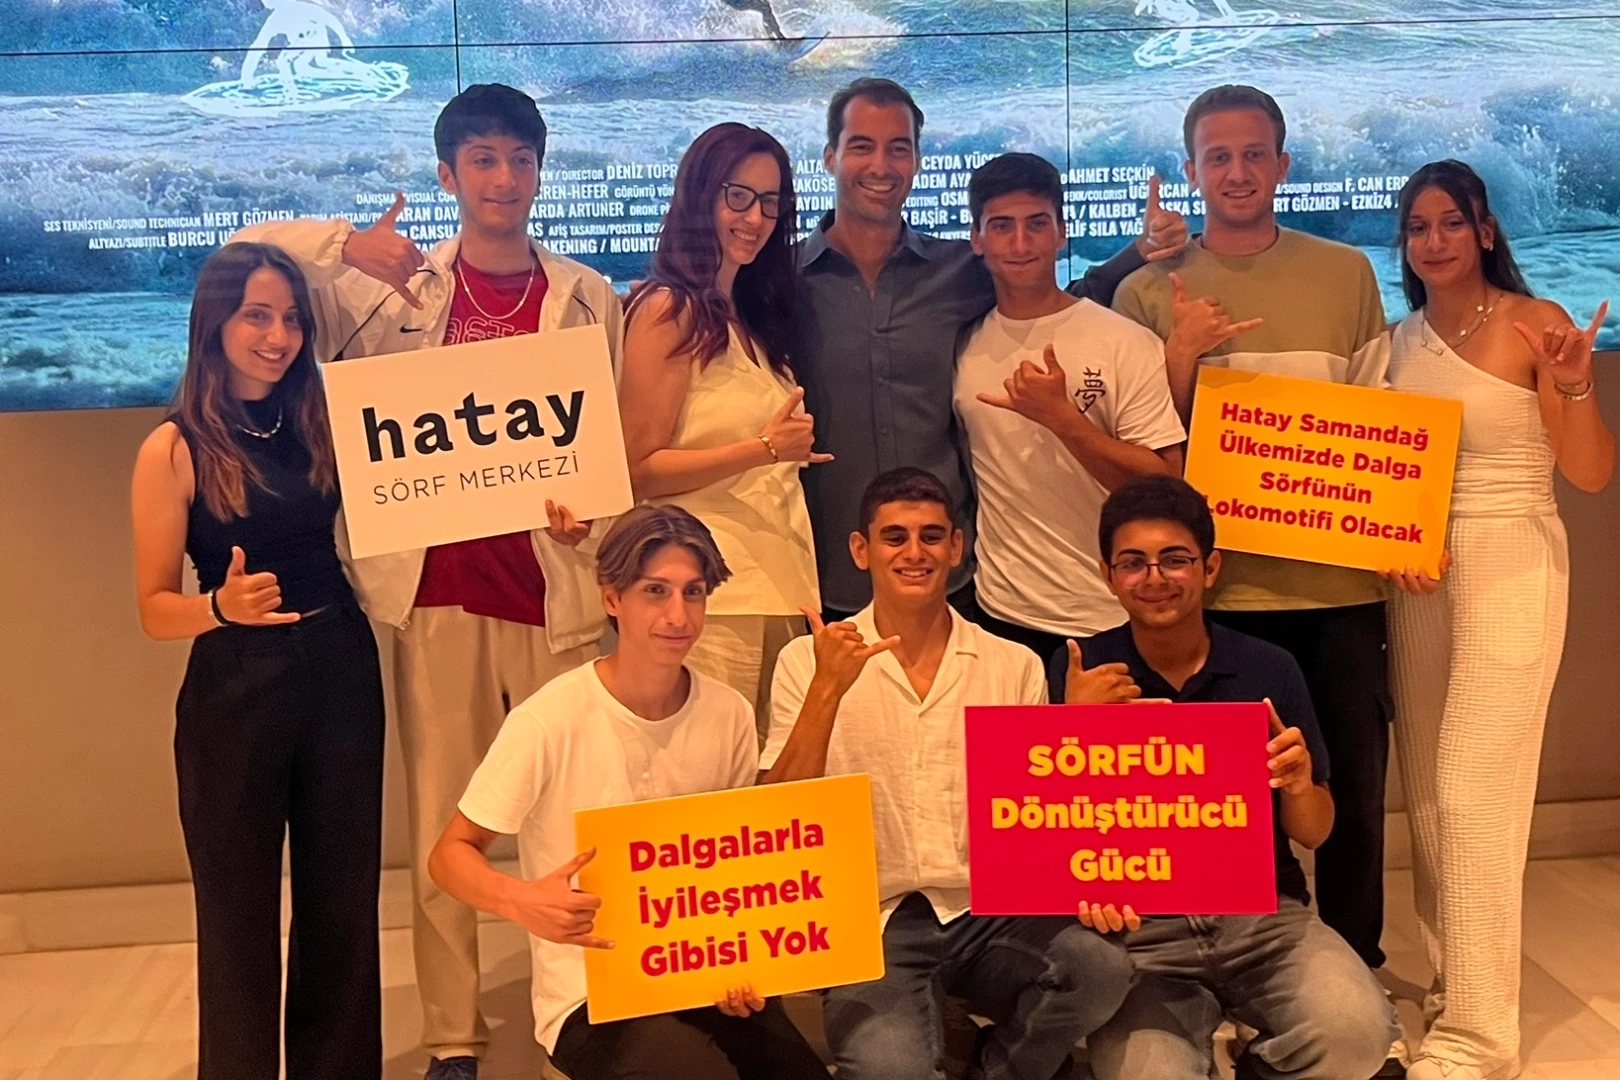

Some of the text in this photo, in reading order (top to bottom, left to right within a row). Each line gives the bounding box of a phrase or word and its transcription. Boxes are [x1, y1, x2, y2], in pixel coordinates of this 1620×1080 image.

[356, 193, 397, 207] DANIŞMA
[534, 184, 609, 200] REN-HEFER
[614, 185, 656, 199] GÖRÜNTÜ
[912, 173, 947, 189] ADEM
[1069, 167, 1110, 184] AHMET
[561, 170, 604, 180] DIRECTOR
[607, 162, 643, 180] DENİZ
[796, 159, 827, 175] ALTA
[921, 155, 961, 171] CEYDA
[43, 220, 61, 232] SES
[148, 216, 200, 229] TECHNICIAN
[203, 211, 239, 228] MERT
[568, 202, 625, 218] ARTUNER
[629, 204, 659, 217] DRONE
[795, 196, 834, 212] AYDIN
[1313, 181, 1344, 193] DESIGN
[1345, 177, 1356, 193] F.
[1358, 176, 1384, 192] CAN
[168, 231, 216, 247] BURCU
[409, 224, 455, 240] CANSU
[548, 223, 569, 239] AFİŞ
[569, 223, 643, 237] TASARIM/POSTER
[910, 207, 949, 229] BAŞİR
[1088, 203, 1138, 220] KALBEN
[1291, 194, 1341, 212] GÖZMEN
[1088, 221, 1118, 238] SILA
[362, 390, 585, 463] hatay
[1220, 402, 1429, 452] Hatay Samandağ
[372, 450, 580, 505] SÖRF MERKEZİ
[1219, 429, 1422, 481] Ülkemizde Dalga
[1259, 471, 1373, 504] Sörfünün
[1206, 495, 1424, 544] okomotifi Olacak
[1027, 736, 1206, 777] SÖRFÜN
[990, 794, 1248, 835] Dönüştürücü
[628, 818, 825, 872] Dalgalarla
[1069, 847, 1172, 882] Gücü
[638, 869, 824, 929] İyileşmek
[640, 920, 831, 977] Gibisi Yok
